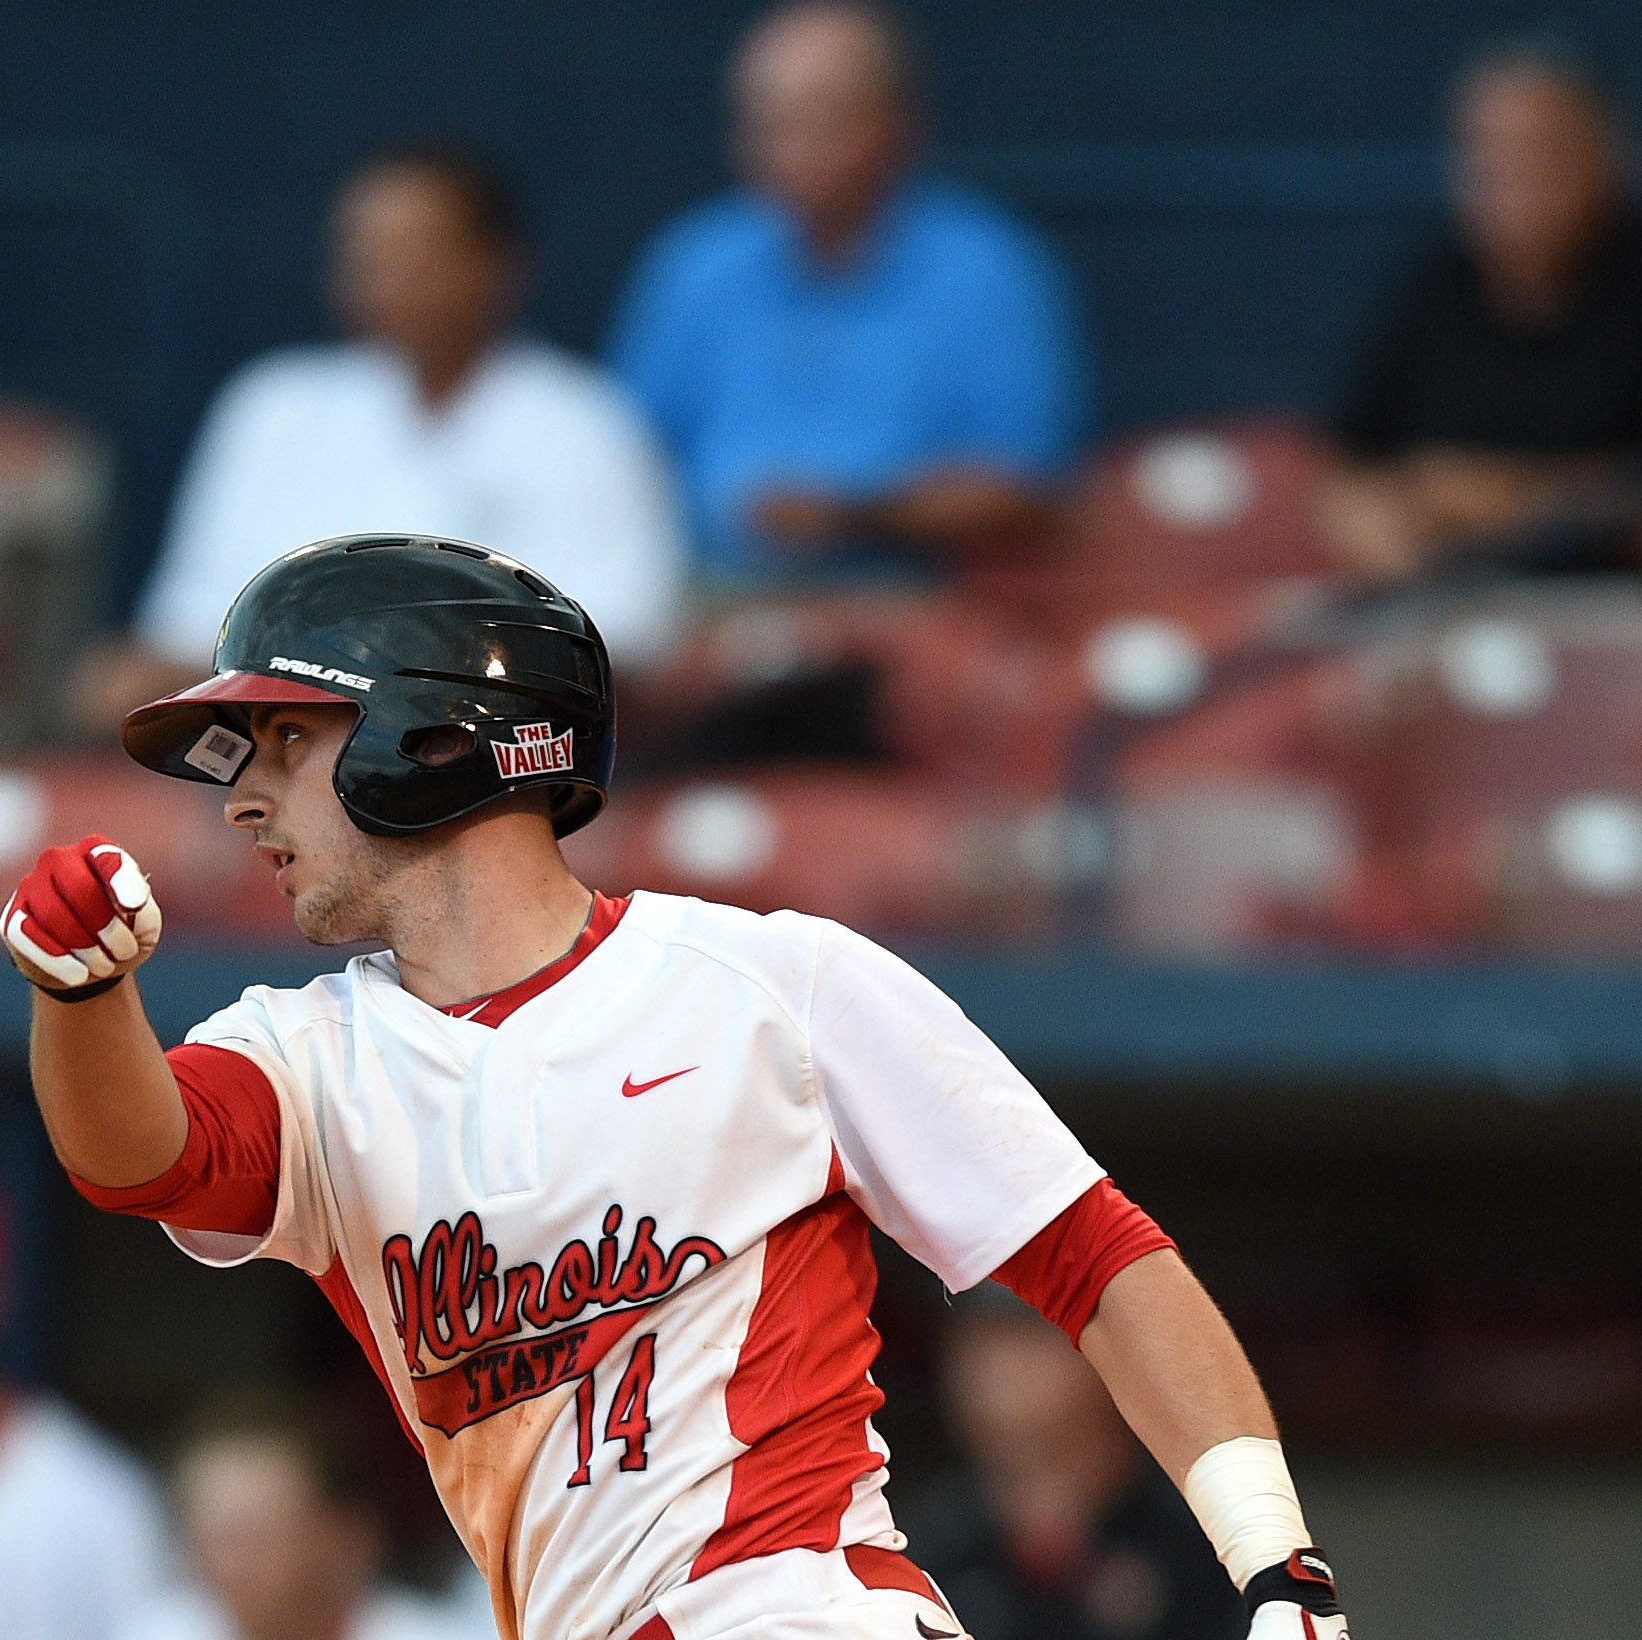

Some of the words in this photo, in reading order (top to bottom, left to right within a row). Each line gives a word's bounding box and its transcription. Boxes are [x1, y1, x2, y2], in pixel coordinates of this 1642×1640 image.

[268, 656, 376, 692] RAWLINGS
[493, 732, 572, 776] VALLEY
[516, 725, 551, 743] THE
[382, 1203, 728, 1376] Illinois
[462, 1330, 590, 1414] STATE
[566, 1333, 658, 1489] 14
